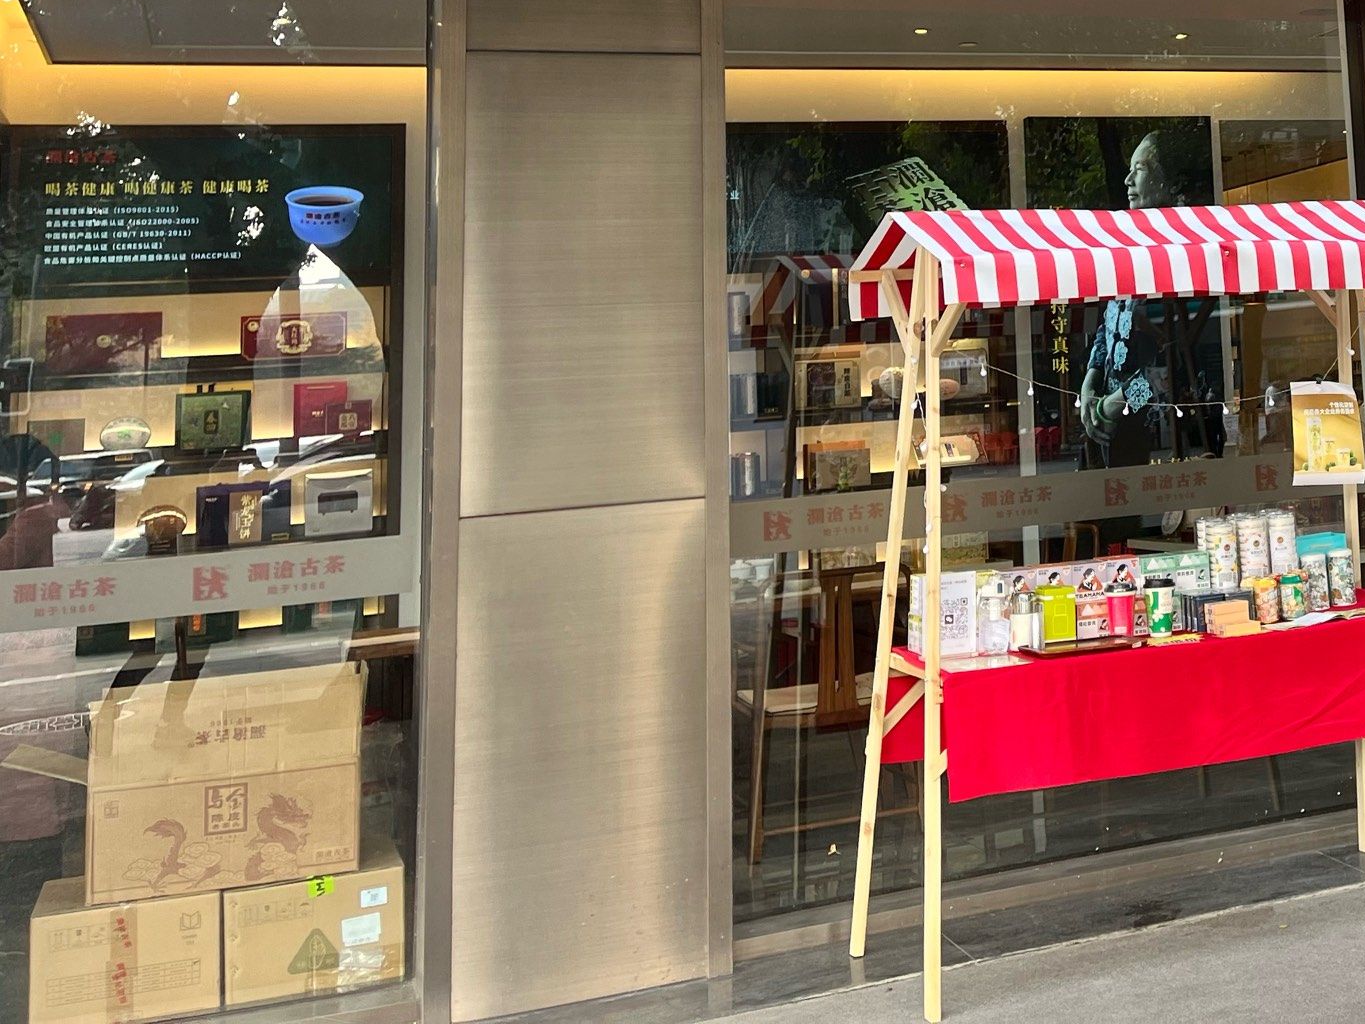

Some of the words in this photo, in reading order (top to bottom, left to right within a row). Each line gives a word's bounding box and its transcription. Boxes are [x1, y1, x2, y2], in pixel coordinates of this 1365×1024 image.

[45, 181, 115, 196] 喝茶健康
[124, 180, 194, 196] 喝健康茶
[202, 178, 269, 194] 健康喝茶
